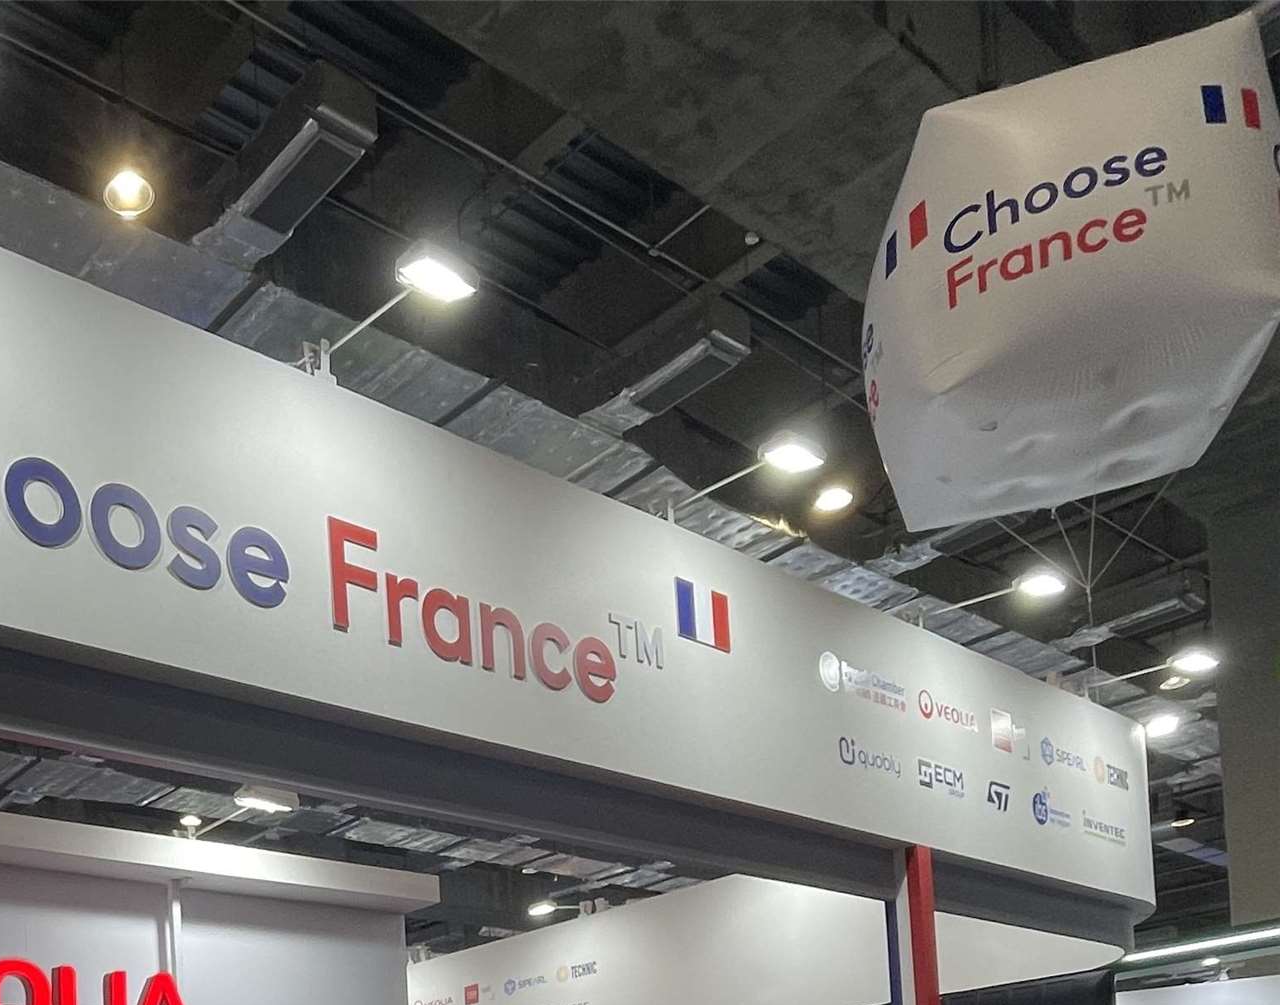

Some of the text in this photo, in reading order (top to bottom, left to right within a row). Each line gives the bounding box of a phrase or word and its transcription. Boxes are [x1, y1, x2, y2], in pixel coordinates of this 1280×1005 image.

[943, 146, 1168, 253] Choose
[935, 702, 978, 732] VEOLIA
[858, 750, 902, 778] quobly
[934, 764, 965, 790] ECM
